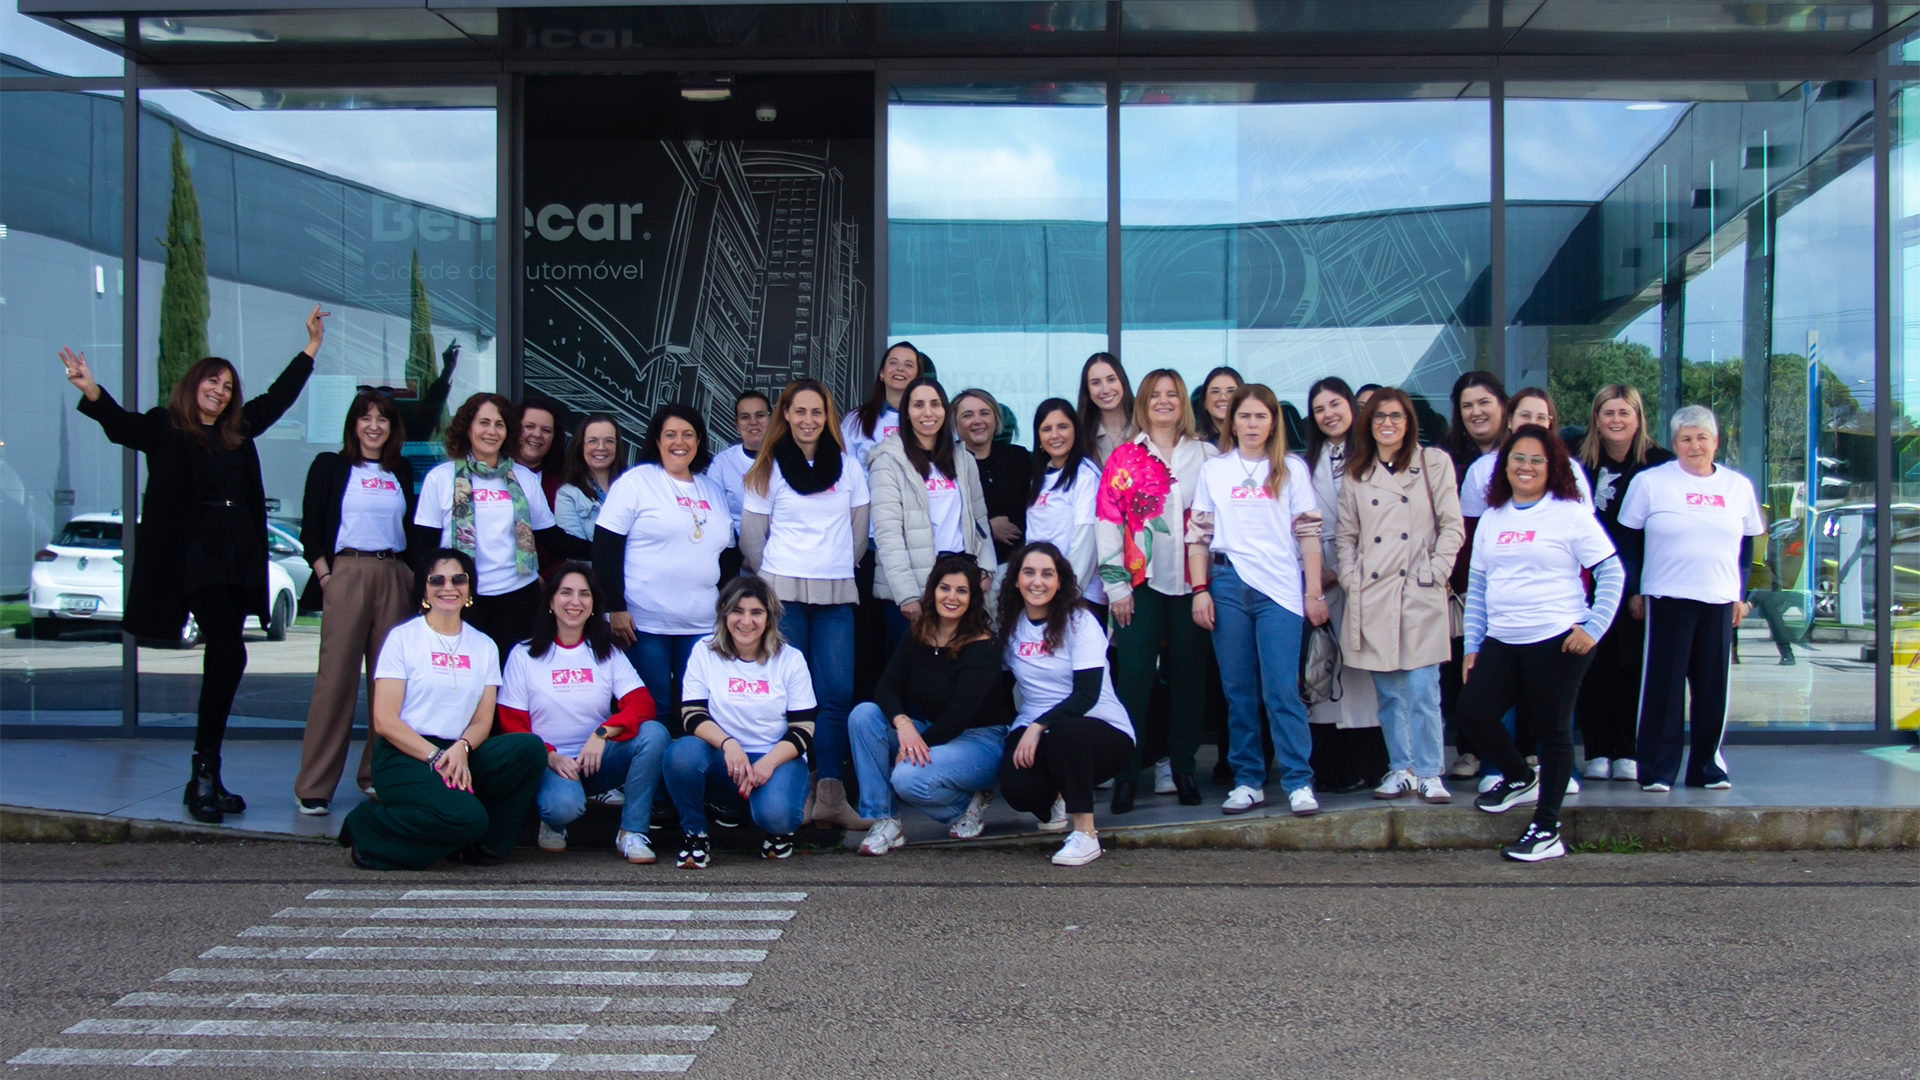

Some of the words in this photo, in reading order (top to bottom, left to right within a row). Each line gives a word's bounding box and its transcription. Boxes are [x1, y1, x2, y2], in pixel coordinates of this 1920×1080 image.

[372, 192, 644, 242] Bencar
[371, 260, 460, 281] Cidade
[526, 259, 644, 281] utomóvel
